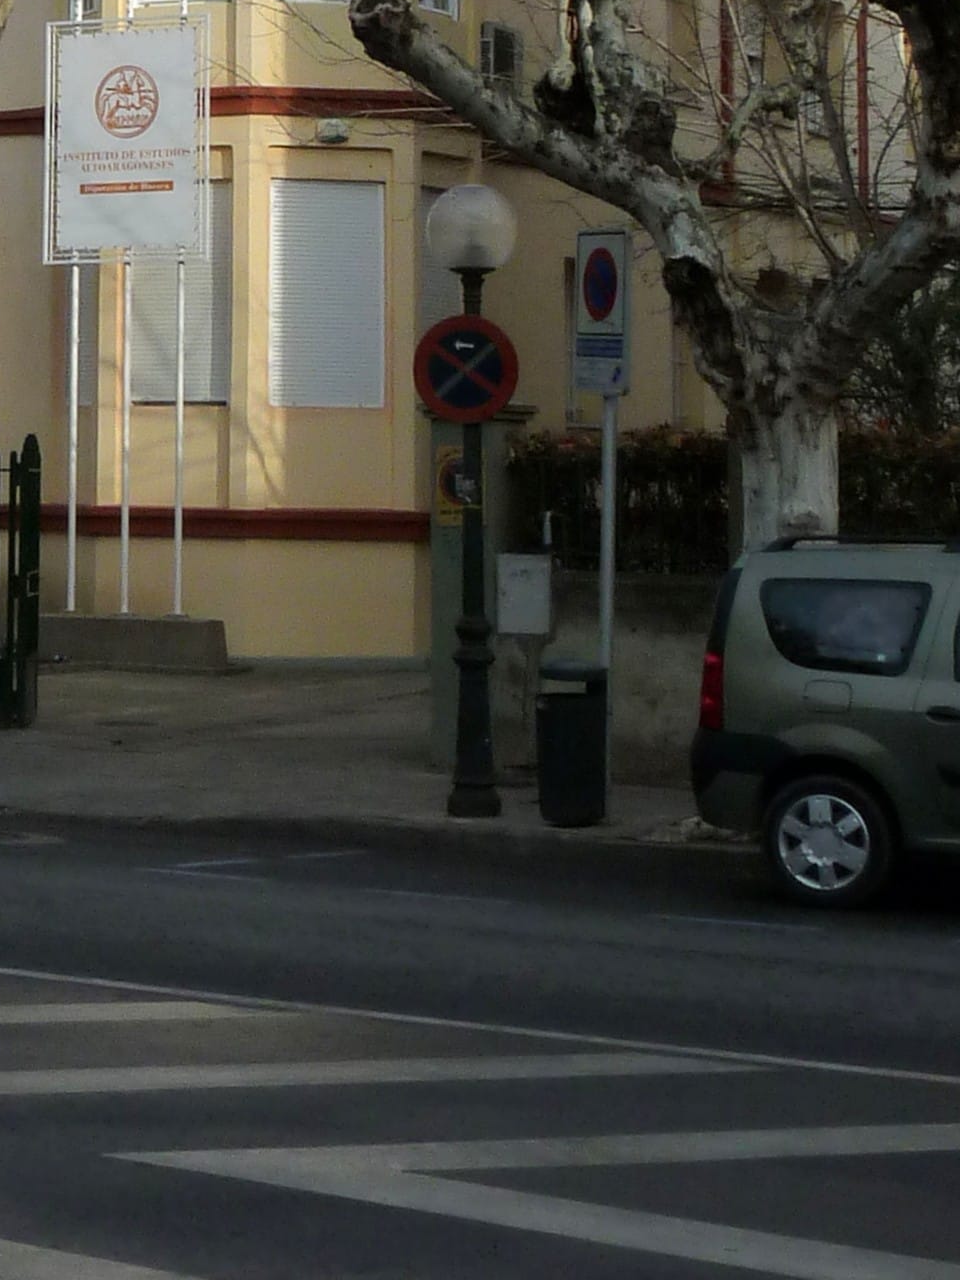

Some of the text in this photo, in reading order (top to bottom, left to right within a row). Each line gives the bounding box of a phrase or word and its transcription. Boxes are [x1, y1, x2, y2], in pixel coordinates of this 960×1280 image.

[63, 147, 191, 161] INSTITUTO DE ESTUDIOS
